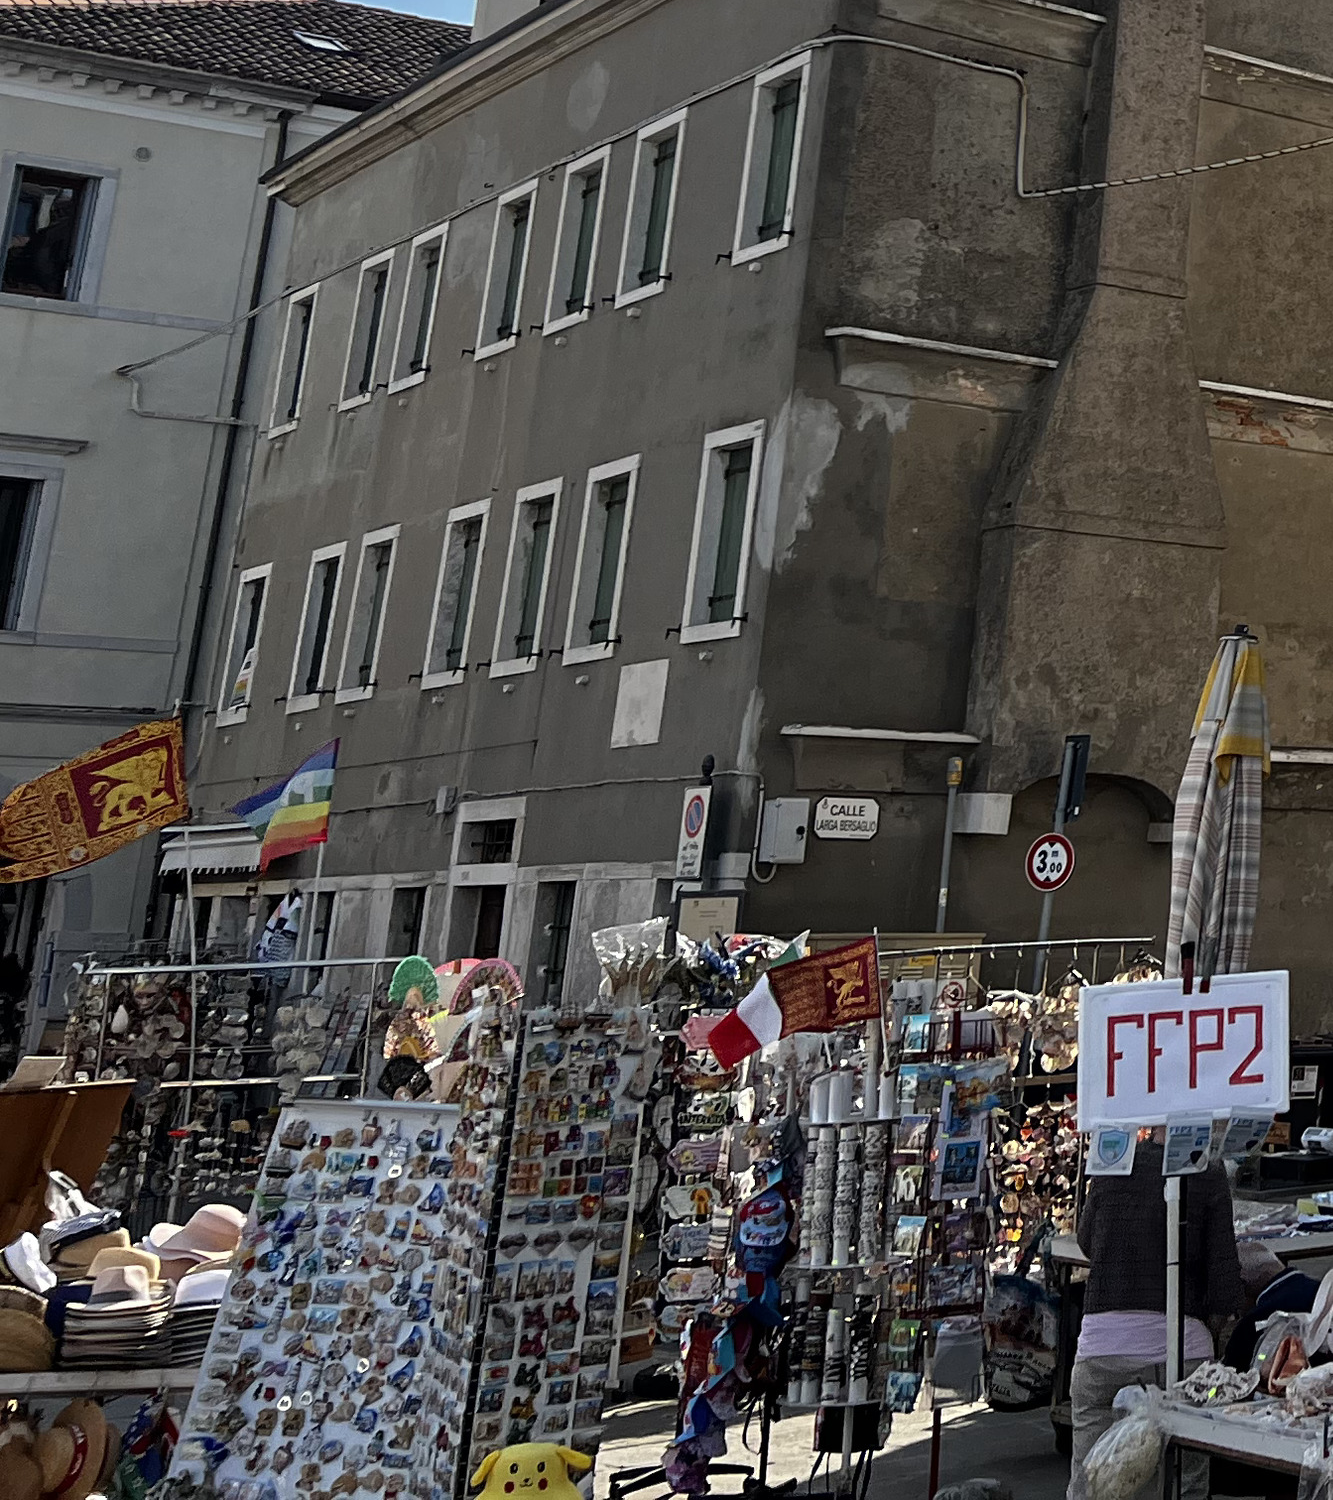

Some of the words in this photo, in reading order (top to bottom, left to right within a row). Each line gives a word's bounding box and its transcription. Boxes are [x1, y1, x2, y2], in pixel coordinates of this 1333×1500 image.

[830, 804, 866, 817] CALLE
[816, 819, 838, 831] LARGA
[839, 820, 876, 832] BERSAGLIO
[1107, 1005, 1264, 1098] FFP2
[1169, 1126, 1192, 1135] FFP2
